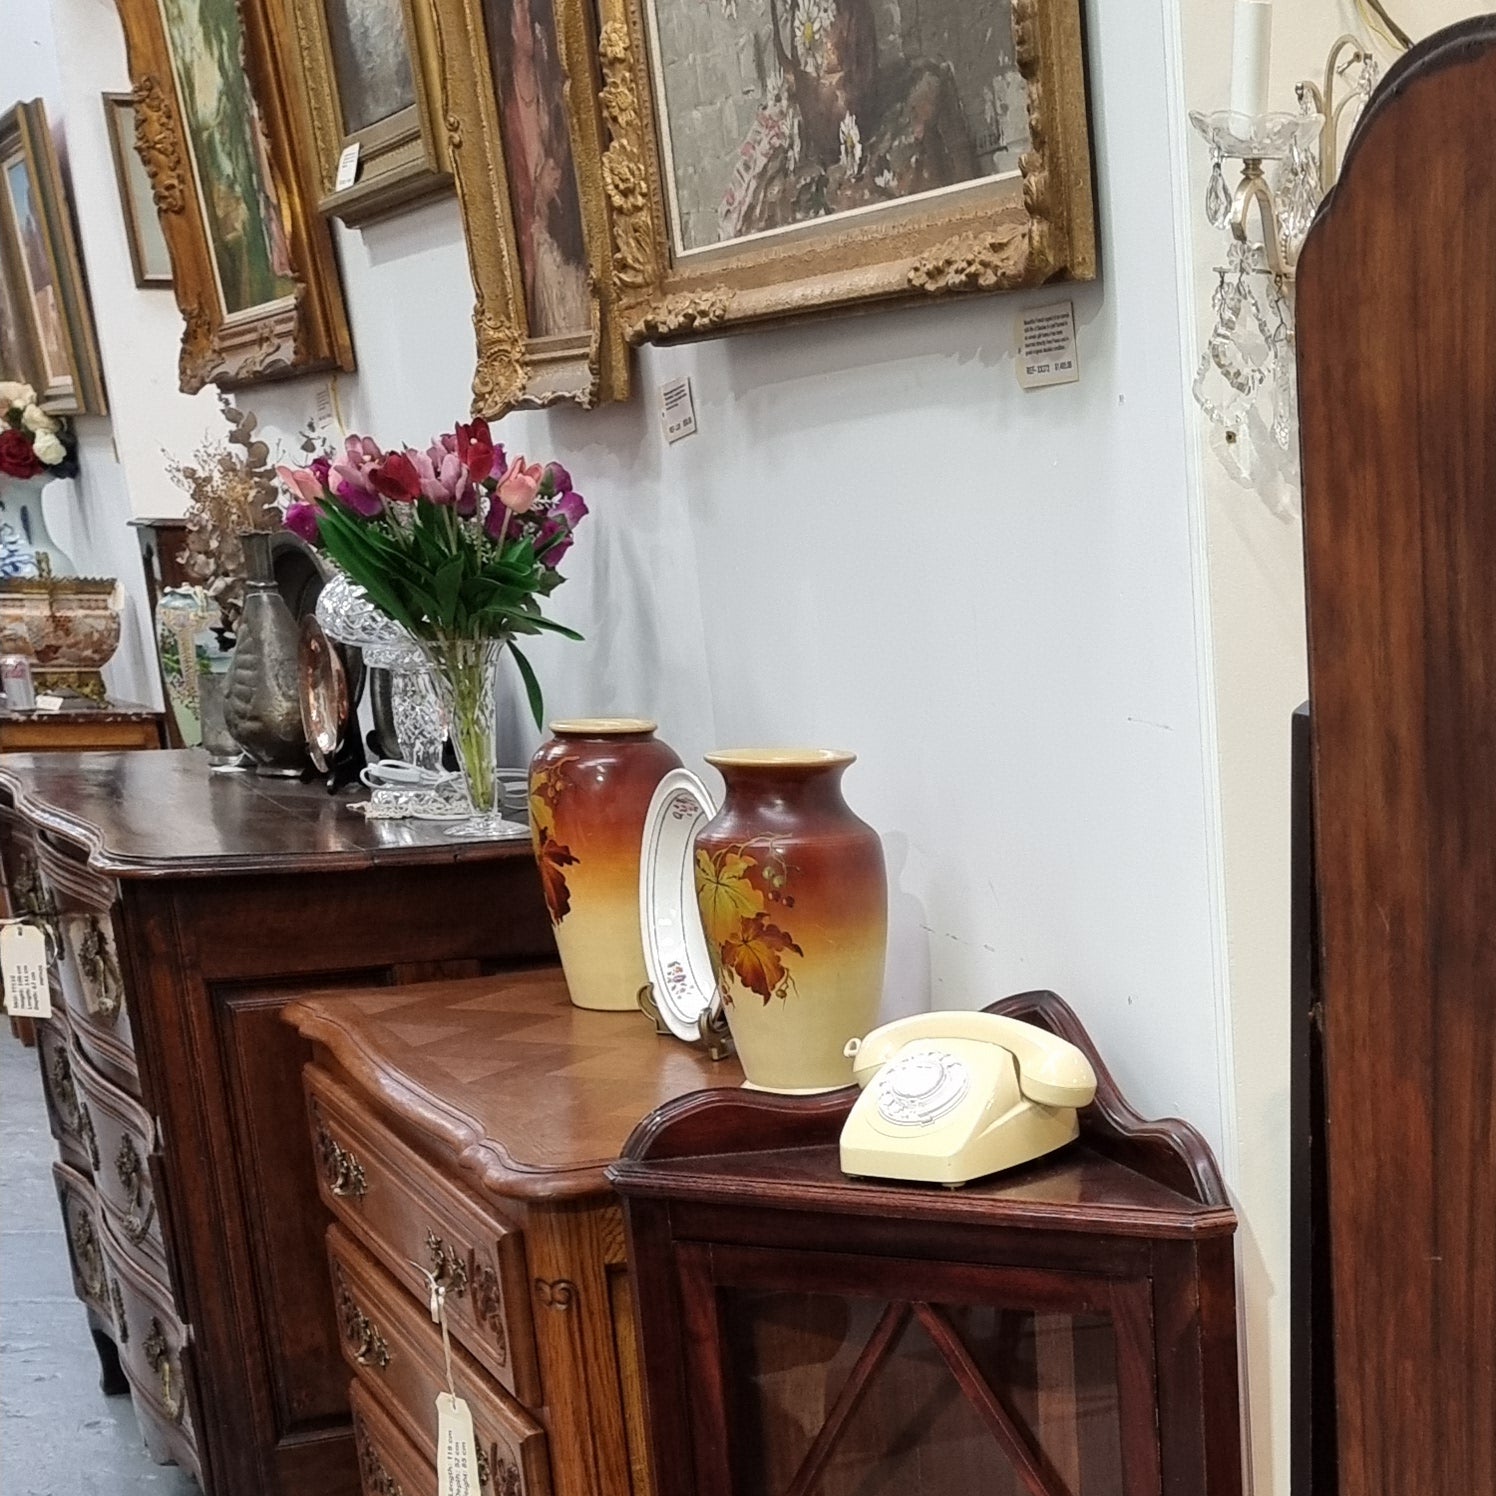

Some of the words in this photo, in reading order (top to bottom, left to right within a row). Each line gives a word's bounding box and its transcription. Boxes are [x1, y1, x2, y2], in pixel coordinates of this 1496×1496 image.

[447, 1430, 453, 1444] cm
[455, 1441, 461, 1456] cm
[462, 1441, 468, 1455] cm
